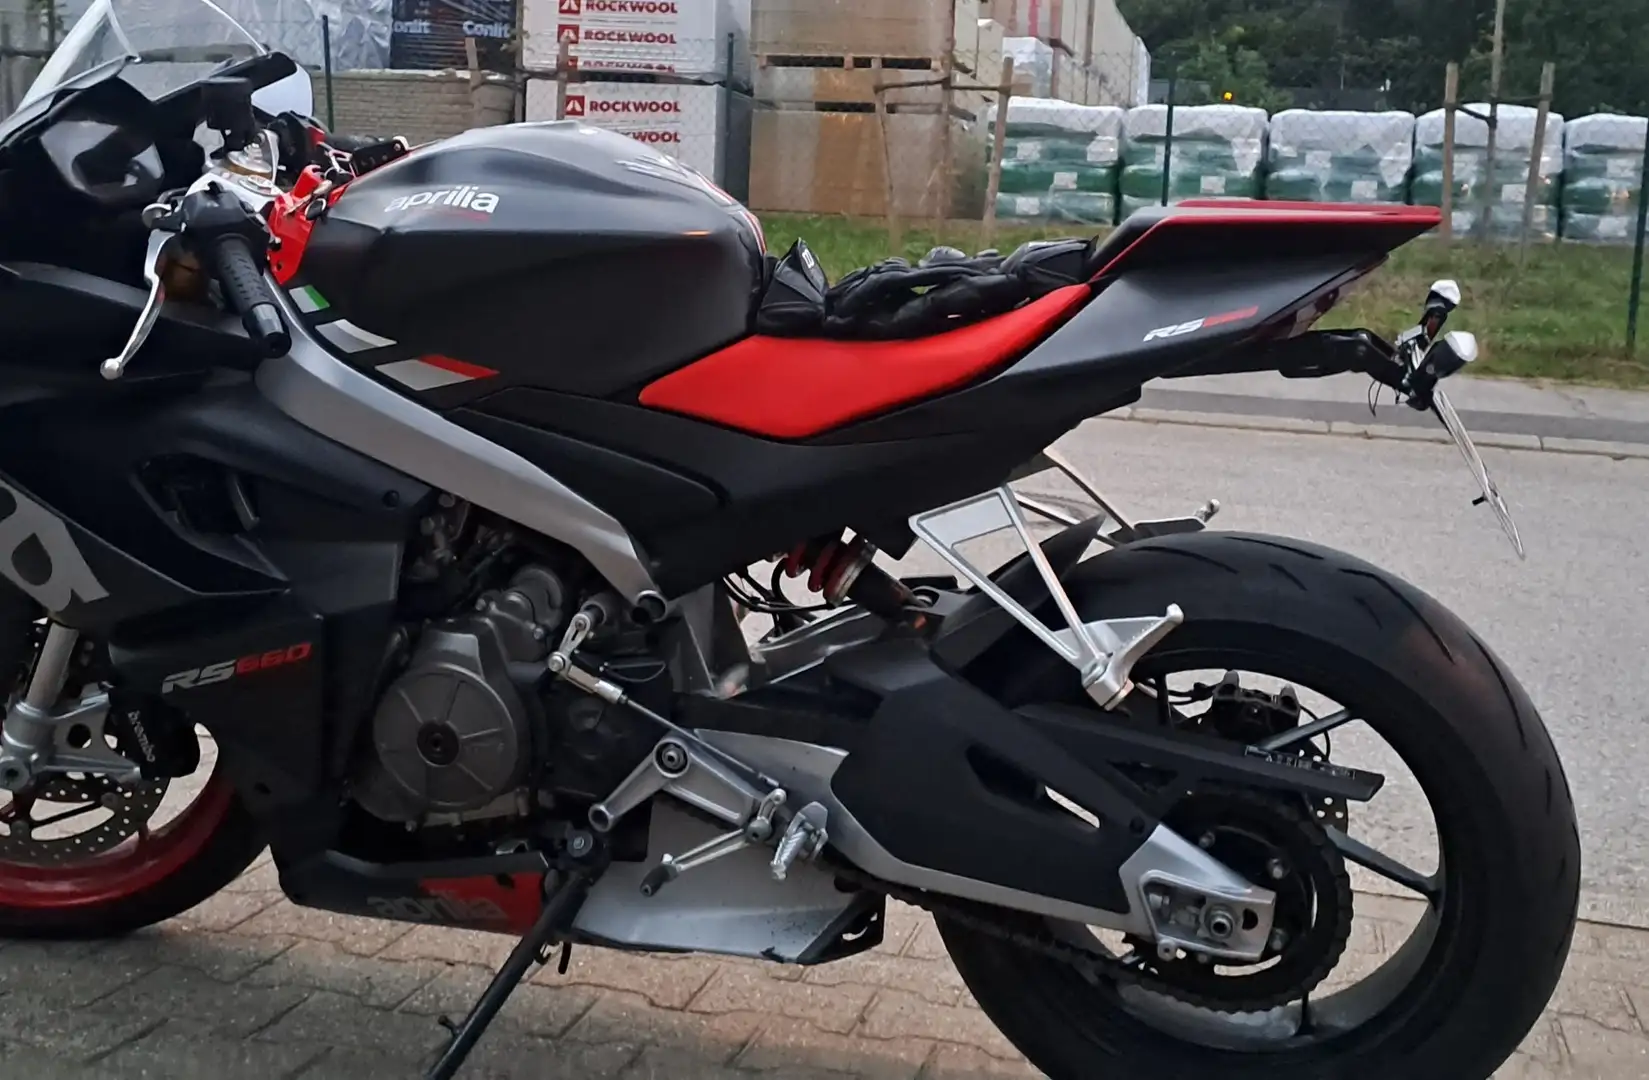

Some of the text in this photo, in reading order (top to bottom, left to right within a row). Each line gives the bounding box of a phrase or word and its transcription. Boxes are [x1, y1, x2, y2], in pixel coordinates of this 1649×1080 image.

[586, 0, 678, 14] ROCKWOOL
[393, 19, 431, 34] onlit
[584, 30, 677, 44] ROCKWOOL
[589, 100, 681, 113] ROCKWOOL
[384, 185, 500, 214] aprilia
[161, 641, 314, 694] RS660
